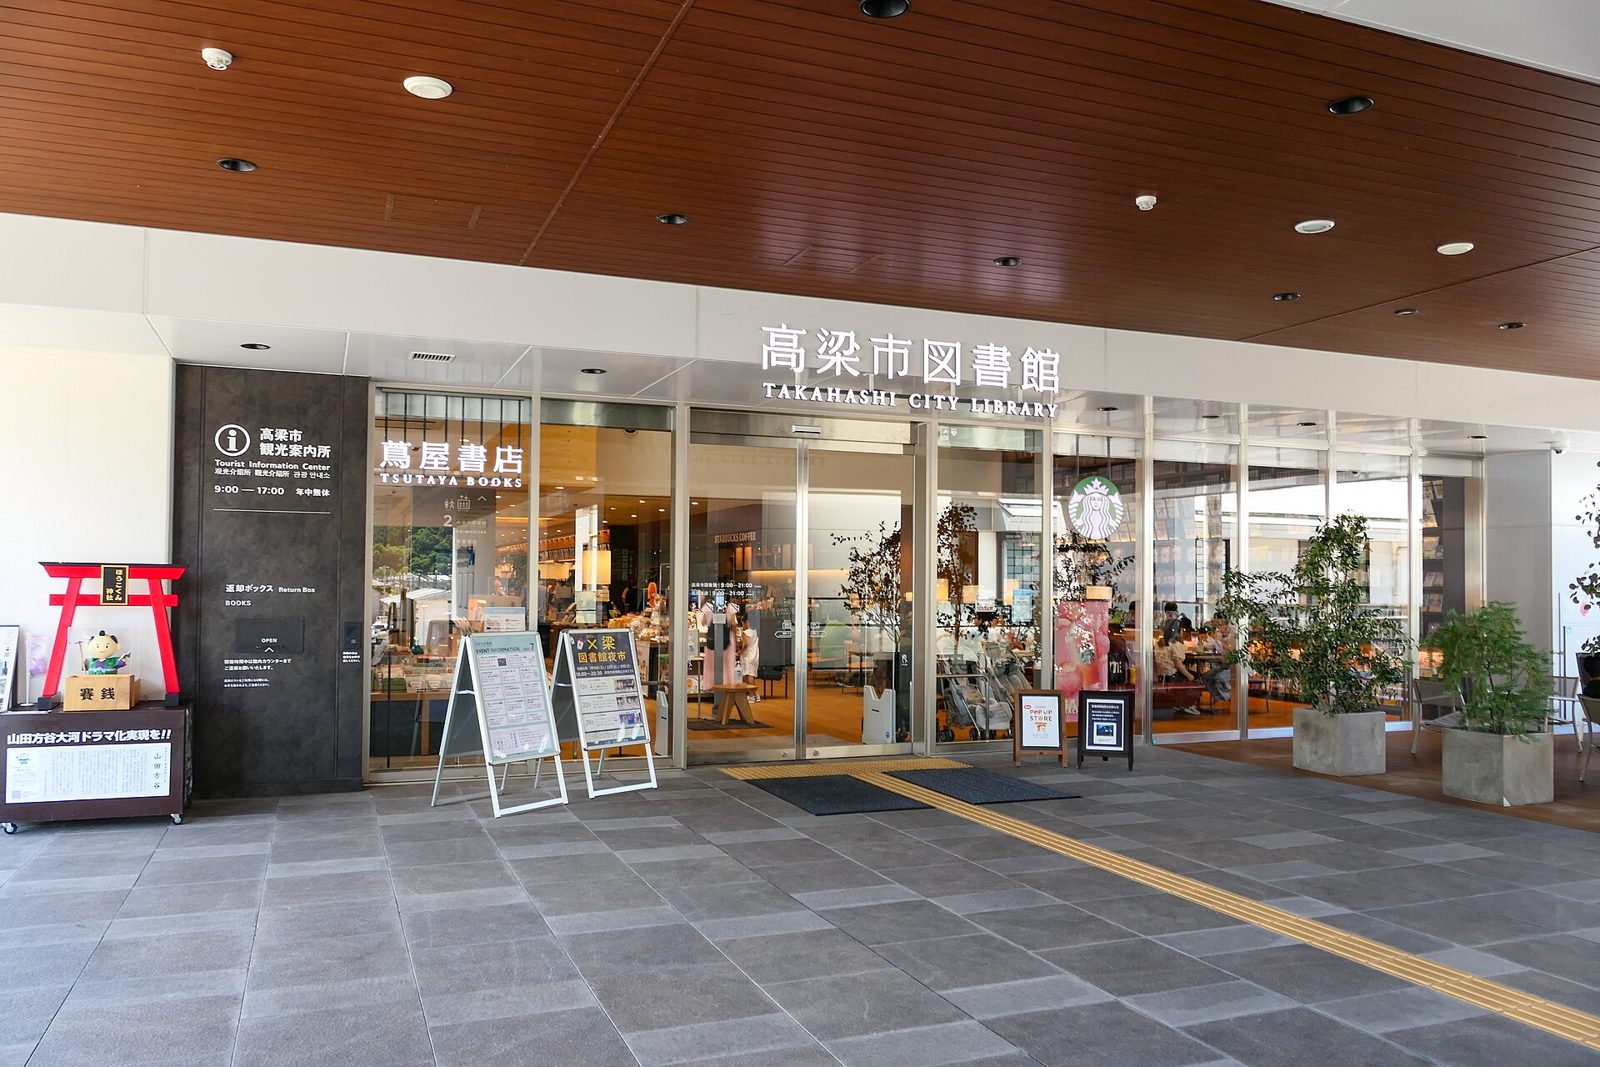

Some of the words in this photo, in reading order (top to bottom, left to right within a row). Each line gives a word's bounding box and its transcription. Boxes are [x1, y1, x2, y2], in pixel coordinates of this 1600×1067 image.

[761, 323, 1060, 394] 高梁市図書館
[762, 382, 897, 407] TAKAHASHI
[908, 393, 960, 412] CITY
[970, 397, 1059, 418] LIBRARY
[260, 428, 303, 443] 高梁市
[259, 443, 331, 459] 観光案内所
[380, 439, 524, 474] 蔦屋書店
[214, 459, 246, 468] Tourist
[249, 460, 299, 470] Information
[302, 462, 331, 471] Center
[380, 473, 459, 487] TSUTAYA
[466, 476, 523, 488] BOOKS
[295, 487, 331, 497] 年中無休
[443, 514, 453, 527] 2
[714, 533, 739, 544] STARBUCKS
[739, 531, 756, 542] COFFEE
[225, 584, 274, 593] 返却ボックス
[601, 635, 616, 650] 梁
[80, 687, 115, 701] 賽銭
